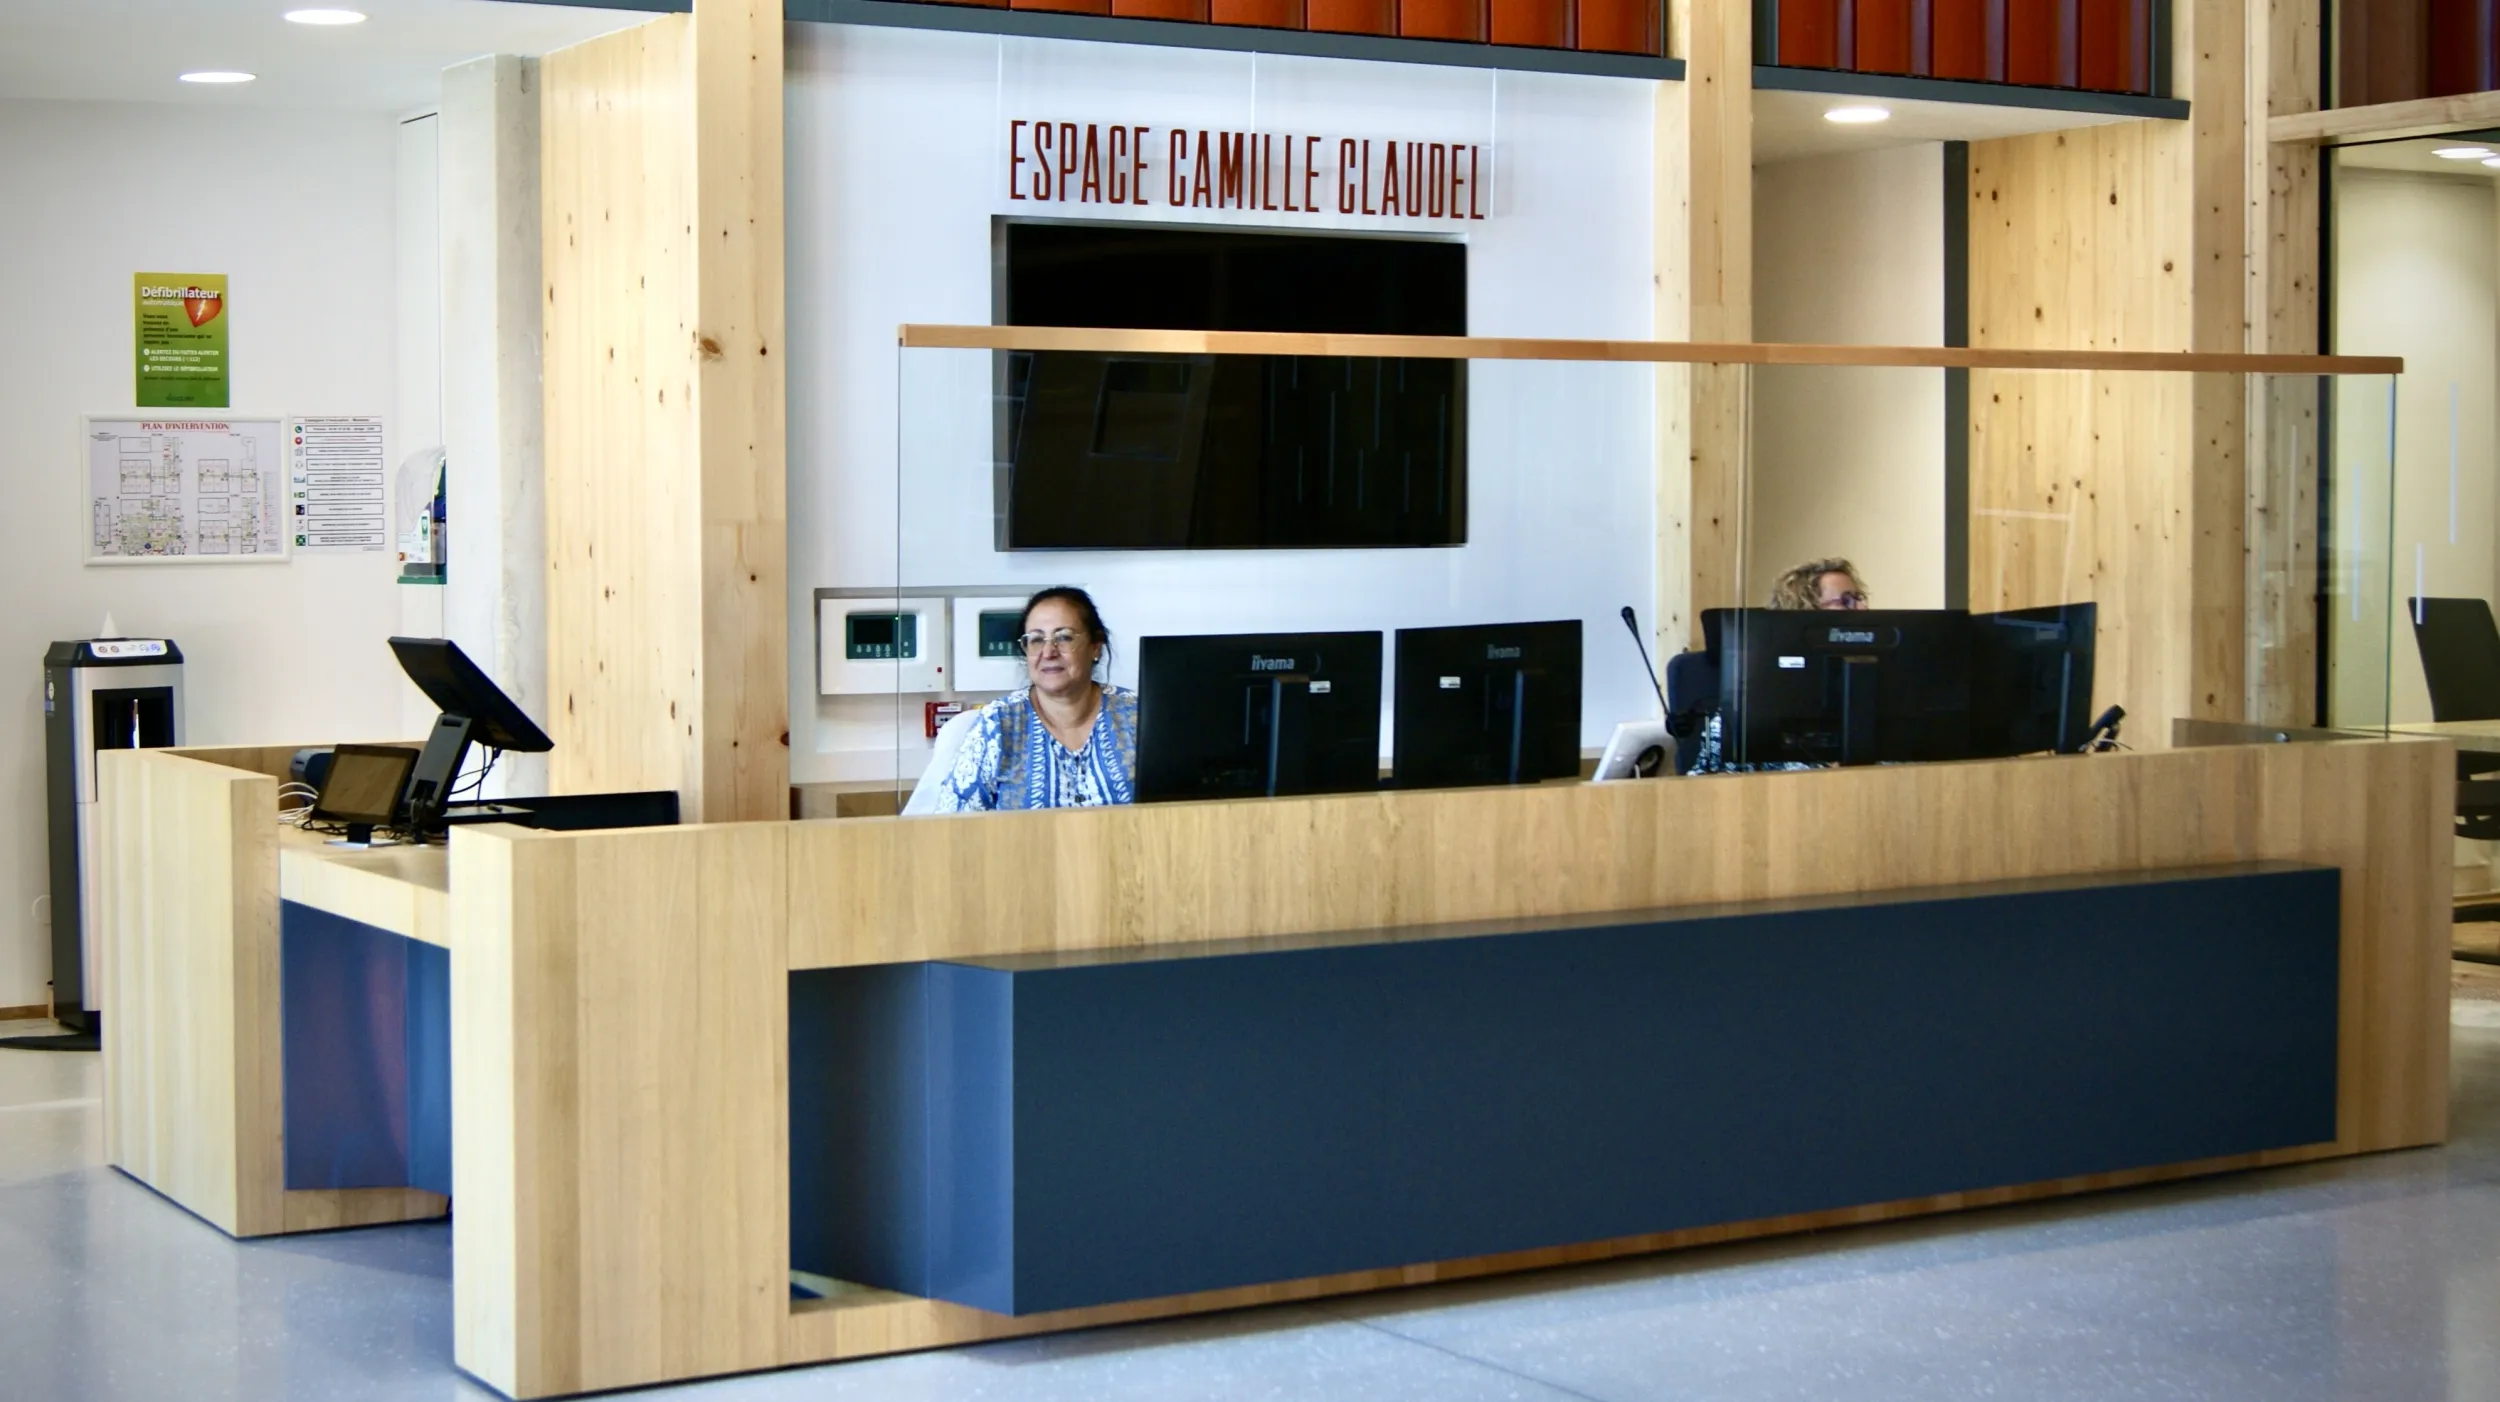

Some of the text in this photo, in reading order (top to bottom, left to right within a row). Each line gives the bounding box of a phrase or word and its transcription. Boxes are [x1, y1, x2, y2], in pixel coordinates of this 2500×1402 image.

[1010, 120, 1485, 220] ESPACE CAMILLE CLAUDEL
[142, 286, 219, 299] Défibrillateur
[142, 422, 230, 430] PLAN D'INTERVENTION
[1251, 654, 1295, 671] iiyama
